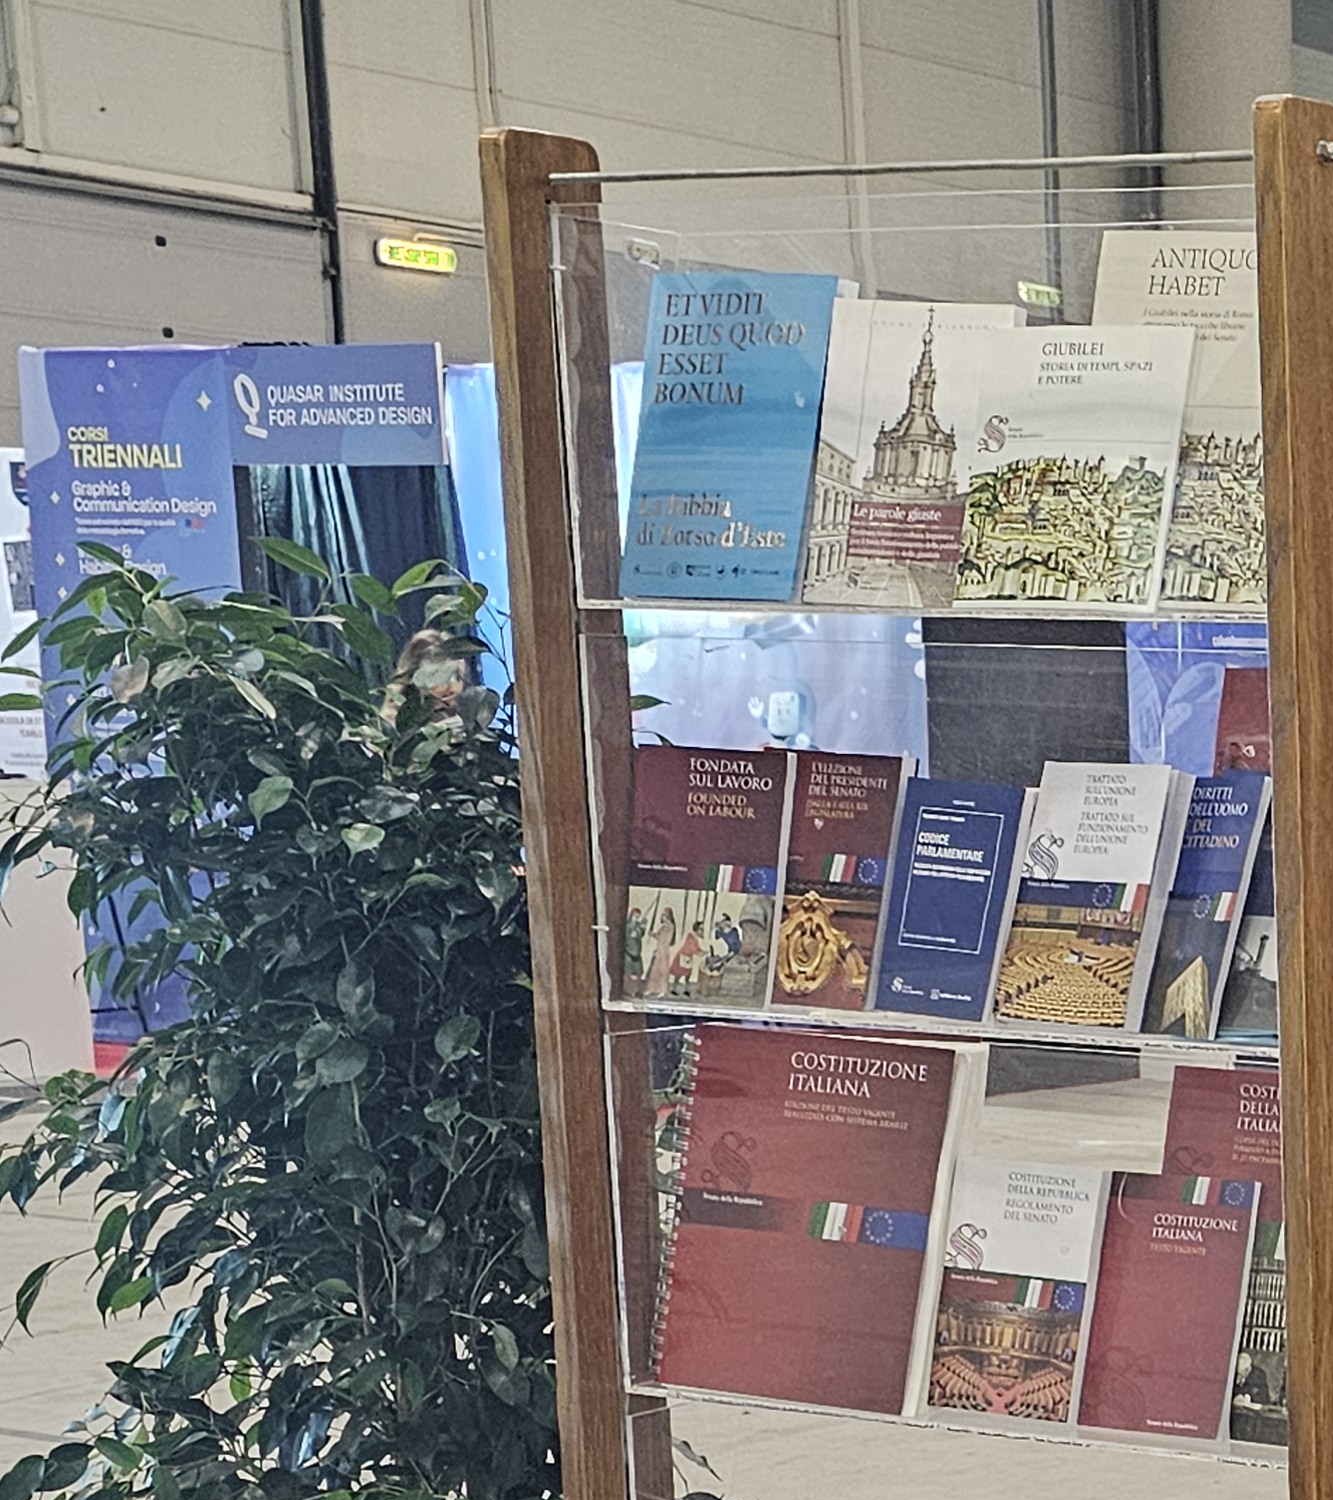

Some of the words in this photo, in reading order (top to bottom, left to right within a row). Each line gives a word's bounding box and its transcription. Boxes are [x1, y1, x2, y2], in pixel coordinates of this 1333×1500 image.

[1148, 275, 1226, 297] HABET
[666, 293, 697, 317] ET
[700, 291, 768, 316] VIDIT
[662, 323, 724, 346] DEUS
[728, 322, 806, 351] QUOD
[1042, 342, 1104, 357] GIUBILEI
[657, 352, 729, 375] ESSET
[267, 384, 325, 404] QUASAR
[329, 383, 405, 403] INSTITUTE
[654, 382, 745, 405] BONUM
[268, 407, 297, 427] FOR
[301, 406, 374, 427] ADVANCED
[378, 405, 433, 426] DESIGN
[67, 426, 109, 442] CORSI
[69, 443, 183, 470] TRIENNALI
[71, 479, 119, 499] Graphic
[121, 481, 131, 497] &
[73, 498, 170, 514] Communication
[171, 498, 217, 515] Design
[853, 504, 868, 518] Le
[869, 506, 906, 520] parole
[907, 507, 942, 523] giuste
[636, 522, 655, 546] di
[690, 757, 755, 776] FONDATA
[689, 773, 713, 788] SUL
[718, 774, 772, 792] LAVORO
[687, 792, 748, 807] FOUNDED
[1192, 786, 1233, 800] DIRITTI
[686, 804, 704, 817] ON
[708, 805, 756, 820] LABOUR
[1192, 818, 1212, 833] DEL
[918, 831, 950, 846] CODICE
[916, 844, 985, 864] PARLAMENTARE
[790, 1051, 928, 1082] COSTITUZIONE
[788, 1073, 871, 1099] ITALIANA
[1236, 1116, 1282, 1133] ITALIA
[1008, 1171, 1076, 1189] COSTITUZIONE
[1007, 1183, 1034, 1196] DELLA
[1036, 1187, 1090, 1202] REPUBBLICA
[1003, 1209, 1020, 1221] DEL
[1022, 1212, 1058, 1225] SENATO
[1153, 1213, 1239, 1233] COSTITUZIONE
[1152, 1227, 1204, 1243] ITALIANA
